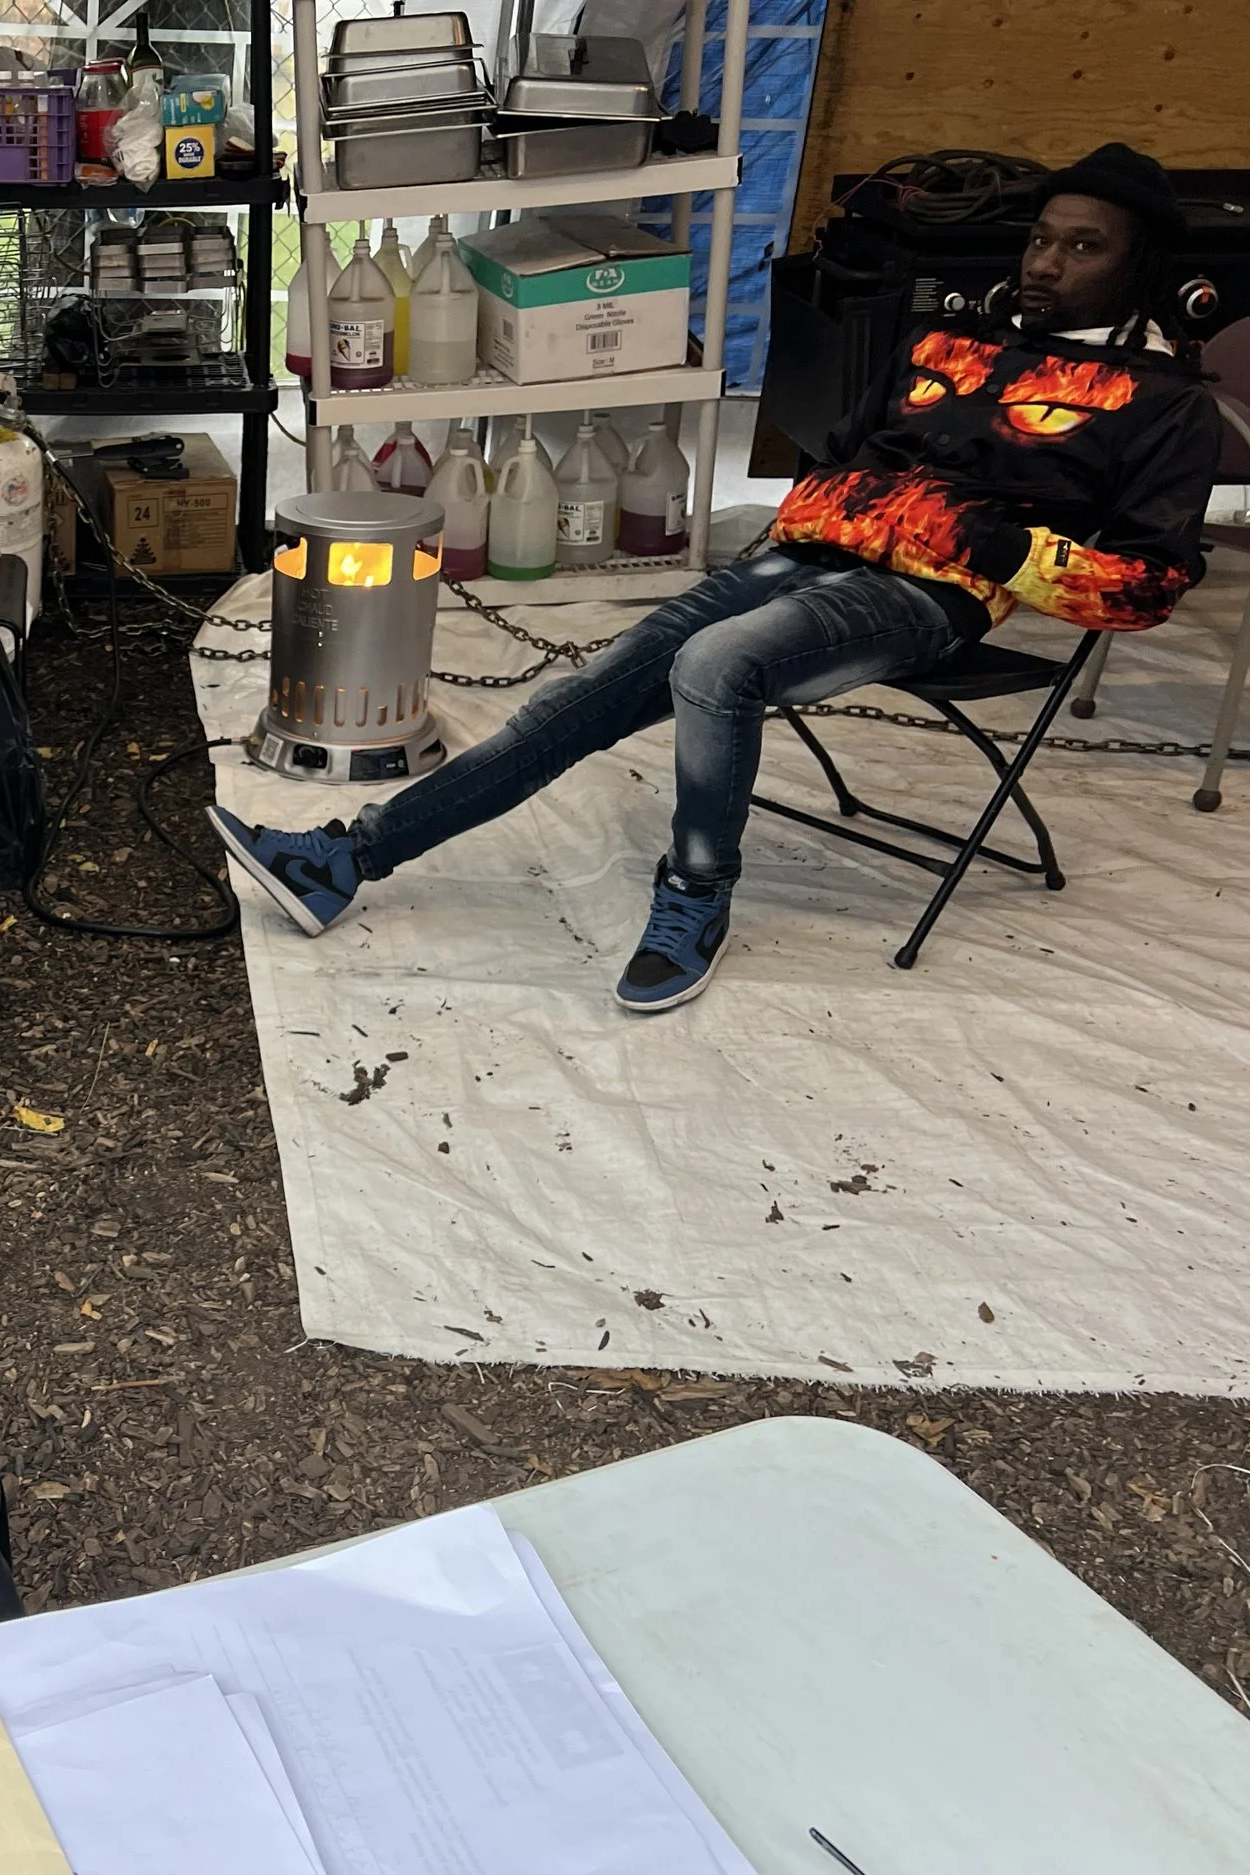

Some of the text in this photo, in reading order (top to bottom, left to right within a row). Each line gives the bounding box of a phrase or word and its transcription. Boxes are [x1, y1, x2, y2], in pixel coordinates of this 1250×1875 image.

[179, 143, 201, 153] 25%
[584, 310, 627, 321] Green Nitrile
[575, 318, 635, 332] Disposable Gloves
[134, 506, 151, 521] 24
